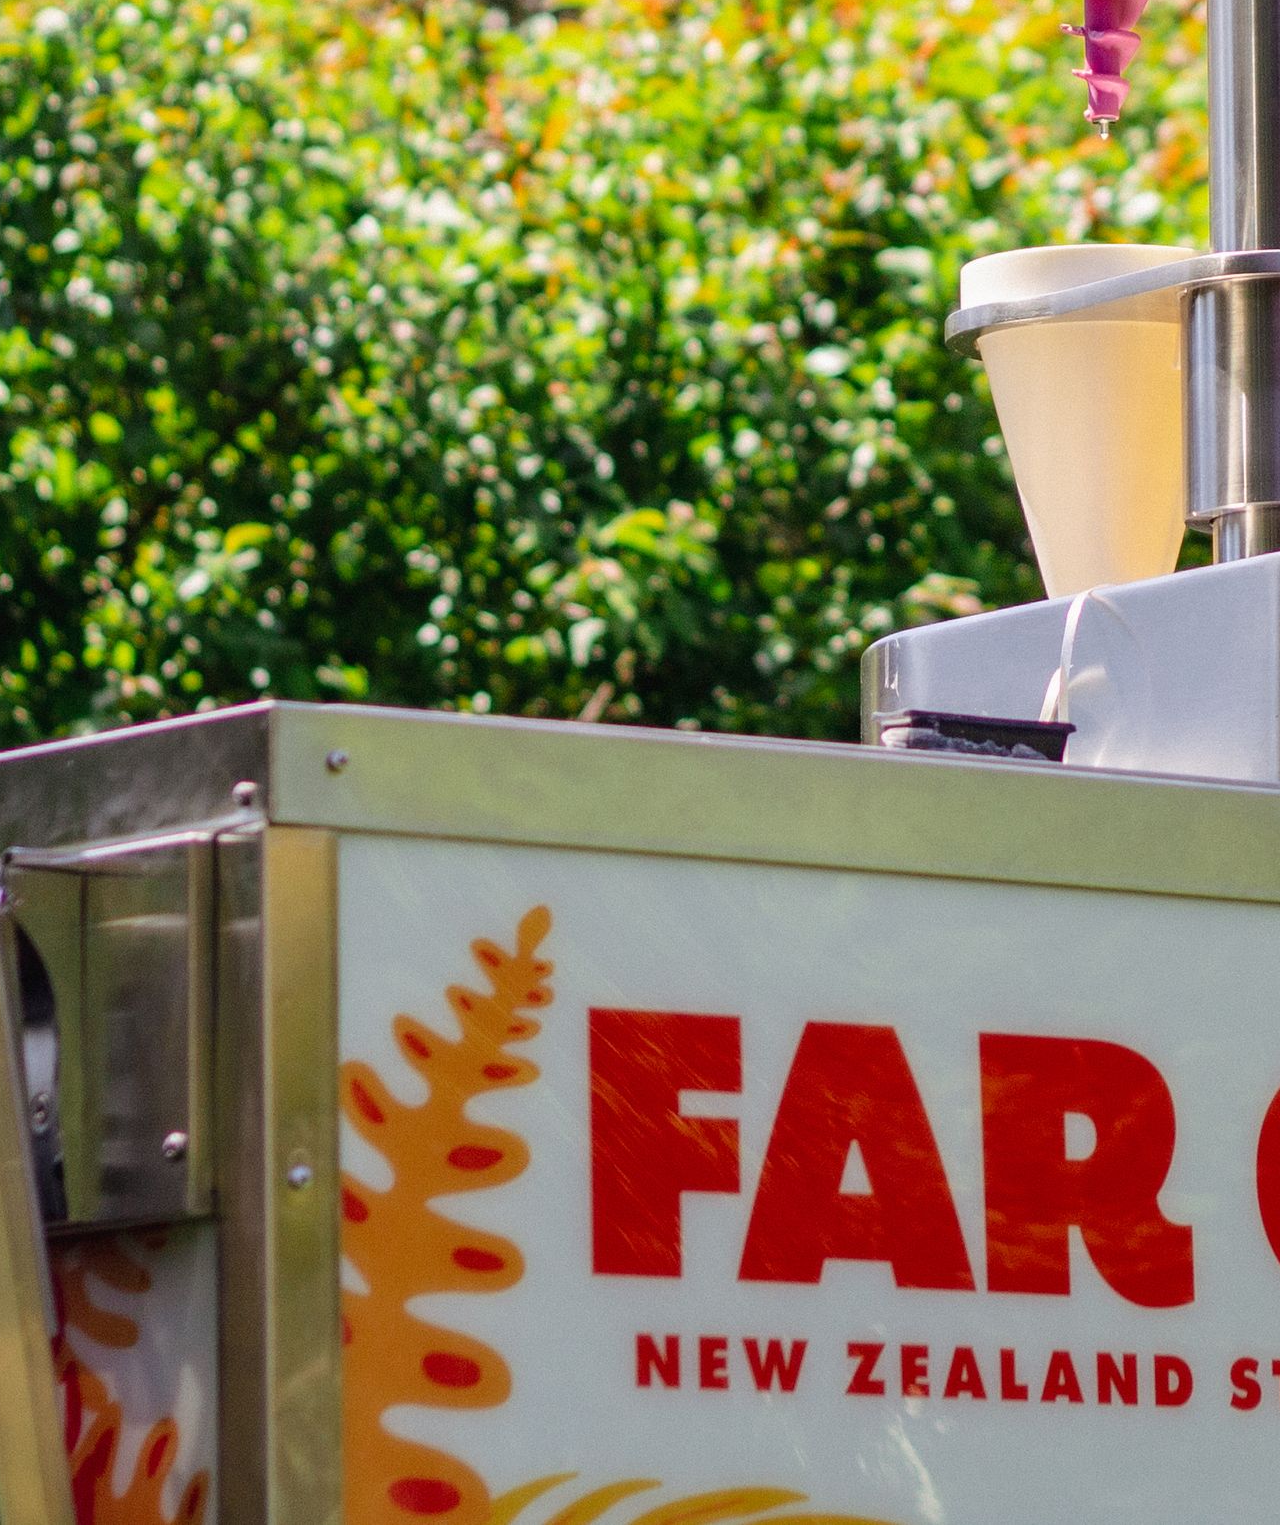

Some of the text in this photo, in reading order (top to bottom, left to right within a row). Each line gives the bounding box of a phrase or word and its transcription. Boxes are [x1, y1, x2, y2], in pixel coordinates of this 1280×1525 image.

[589, 1006, 1195, 1310] FAR
[635, 1333, 808, 1395] NEW
[846, 1340, 1194, 1408] ZEALAND
